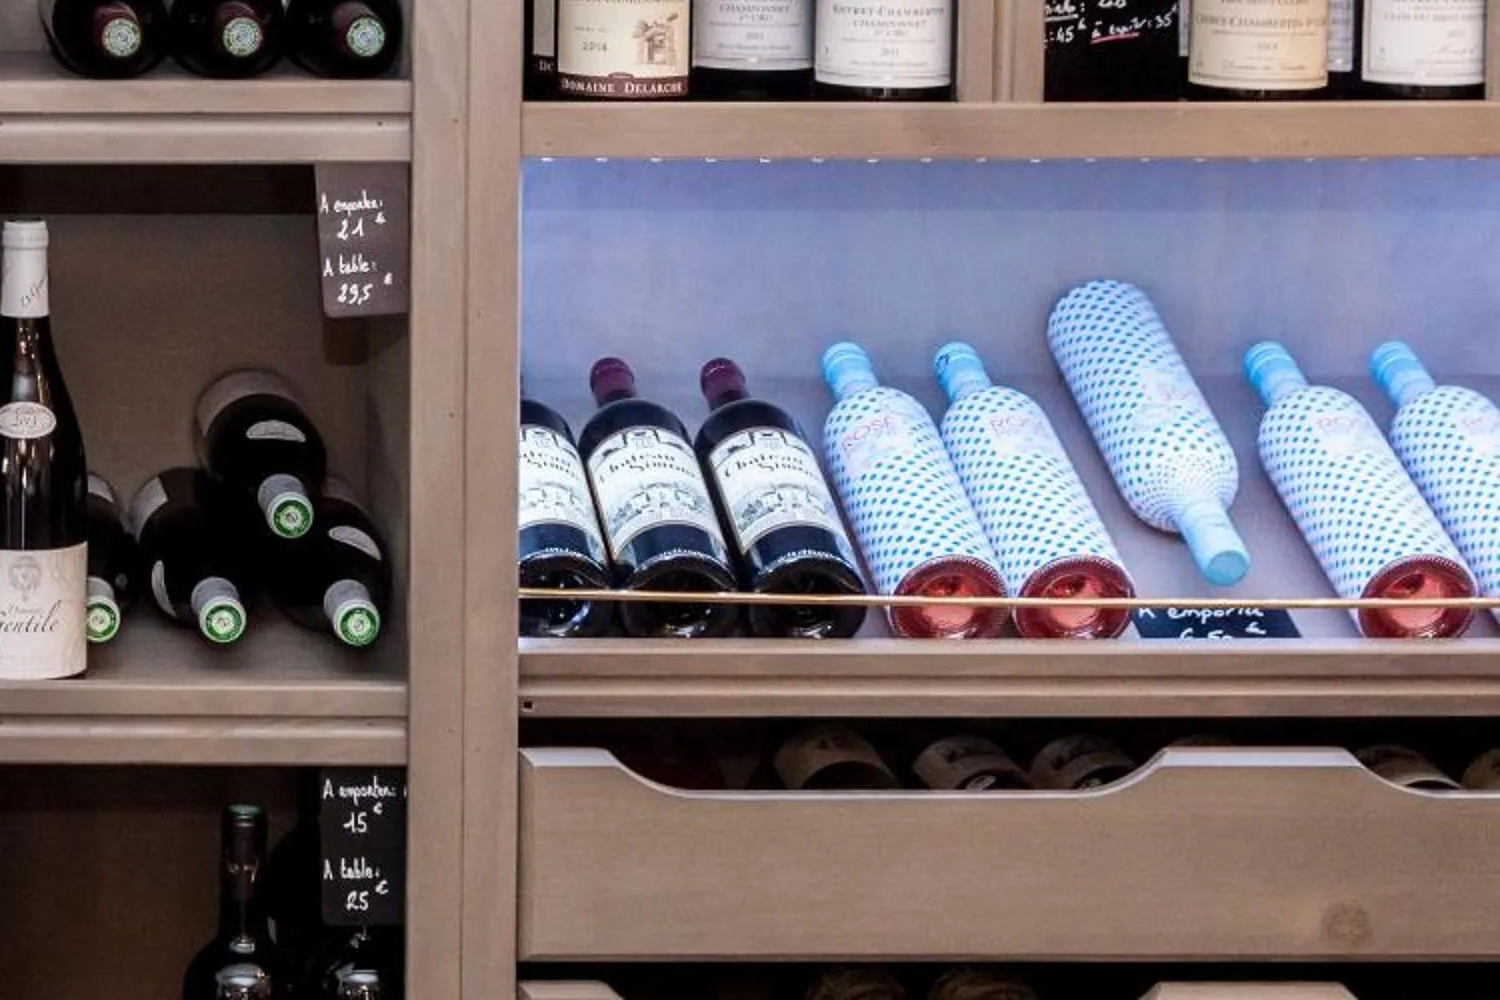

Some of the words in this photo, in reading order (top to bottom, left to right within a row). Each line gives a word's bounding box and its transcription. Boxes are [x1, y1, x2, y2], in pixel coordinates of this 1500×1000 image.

[320, 192, 329, 213] A
[324, 257, 334, 277] A
[323, 778, 334, 799] A
[323, 858, 334, 880] A
